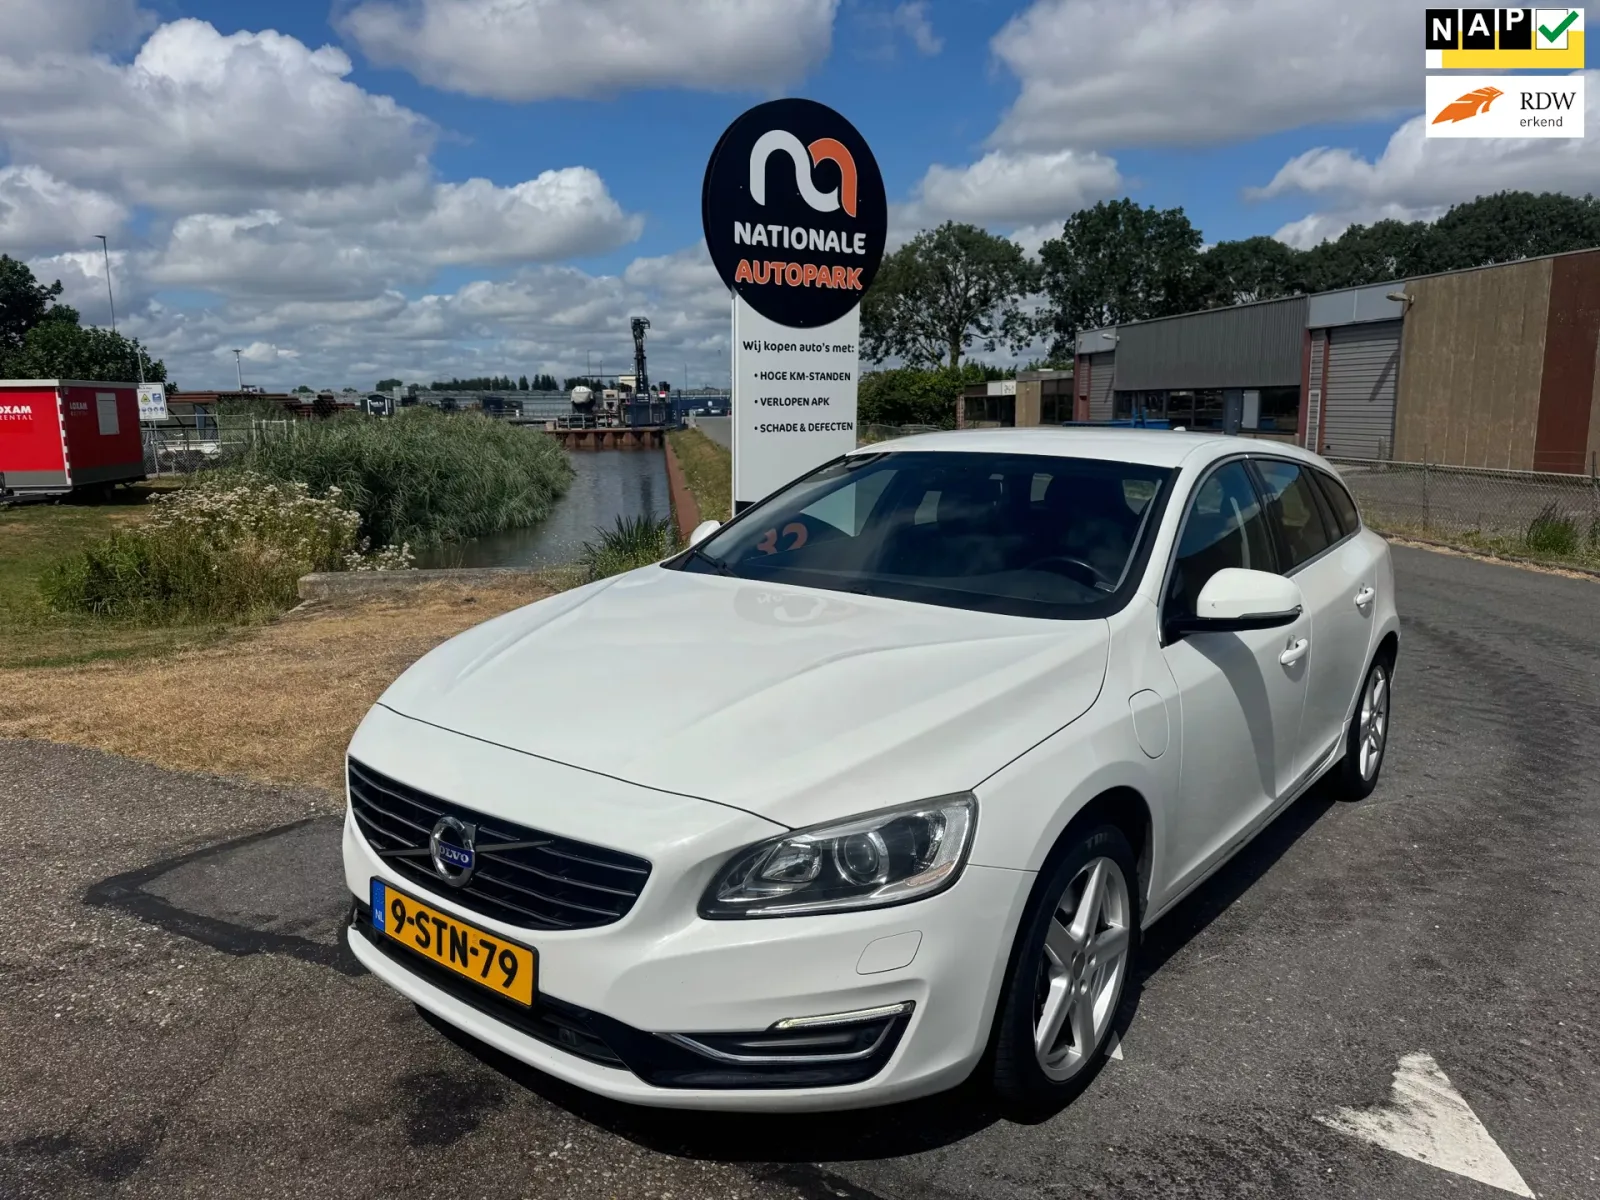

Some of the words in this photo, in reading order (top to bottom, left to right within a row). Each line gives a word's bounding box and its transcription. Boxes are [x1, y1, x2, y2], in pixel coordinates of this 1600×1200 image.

[734, 221, 867, 255] NATIONALE
[734, 258, 864, 291] AUTOPARK
[742, 340, 762, 354] Wij
[764, 340, 797, 354] kopen
[799, 342, 831, 353] auto's
[833, 343, 855, 353] met:
[760, 371, 788, 381] HOGE
[789, 371, 851, 381] KM-STANDEN
[760, 397, 810, 407] VERLOPEN
[811, 397, 830, 407] APK
[760, 423, 799, 433] SCHADE
[800, 422, 807, 433] &
[808, 421, 853, 432] DEFECTEN
[439, 845, 470, 864] OLVO
[375, 908, 385, 923] NL
[391, 898, 519, 989] 9-STN-79
